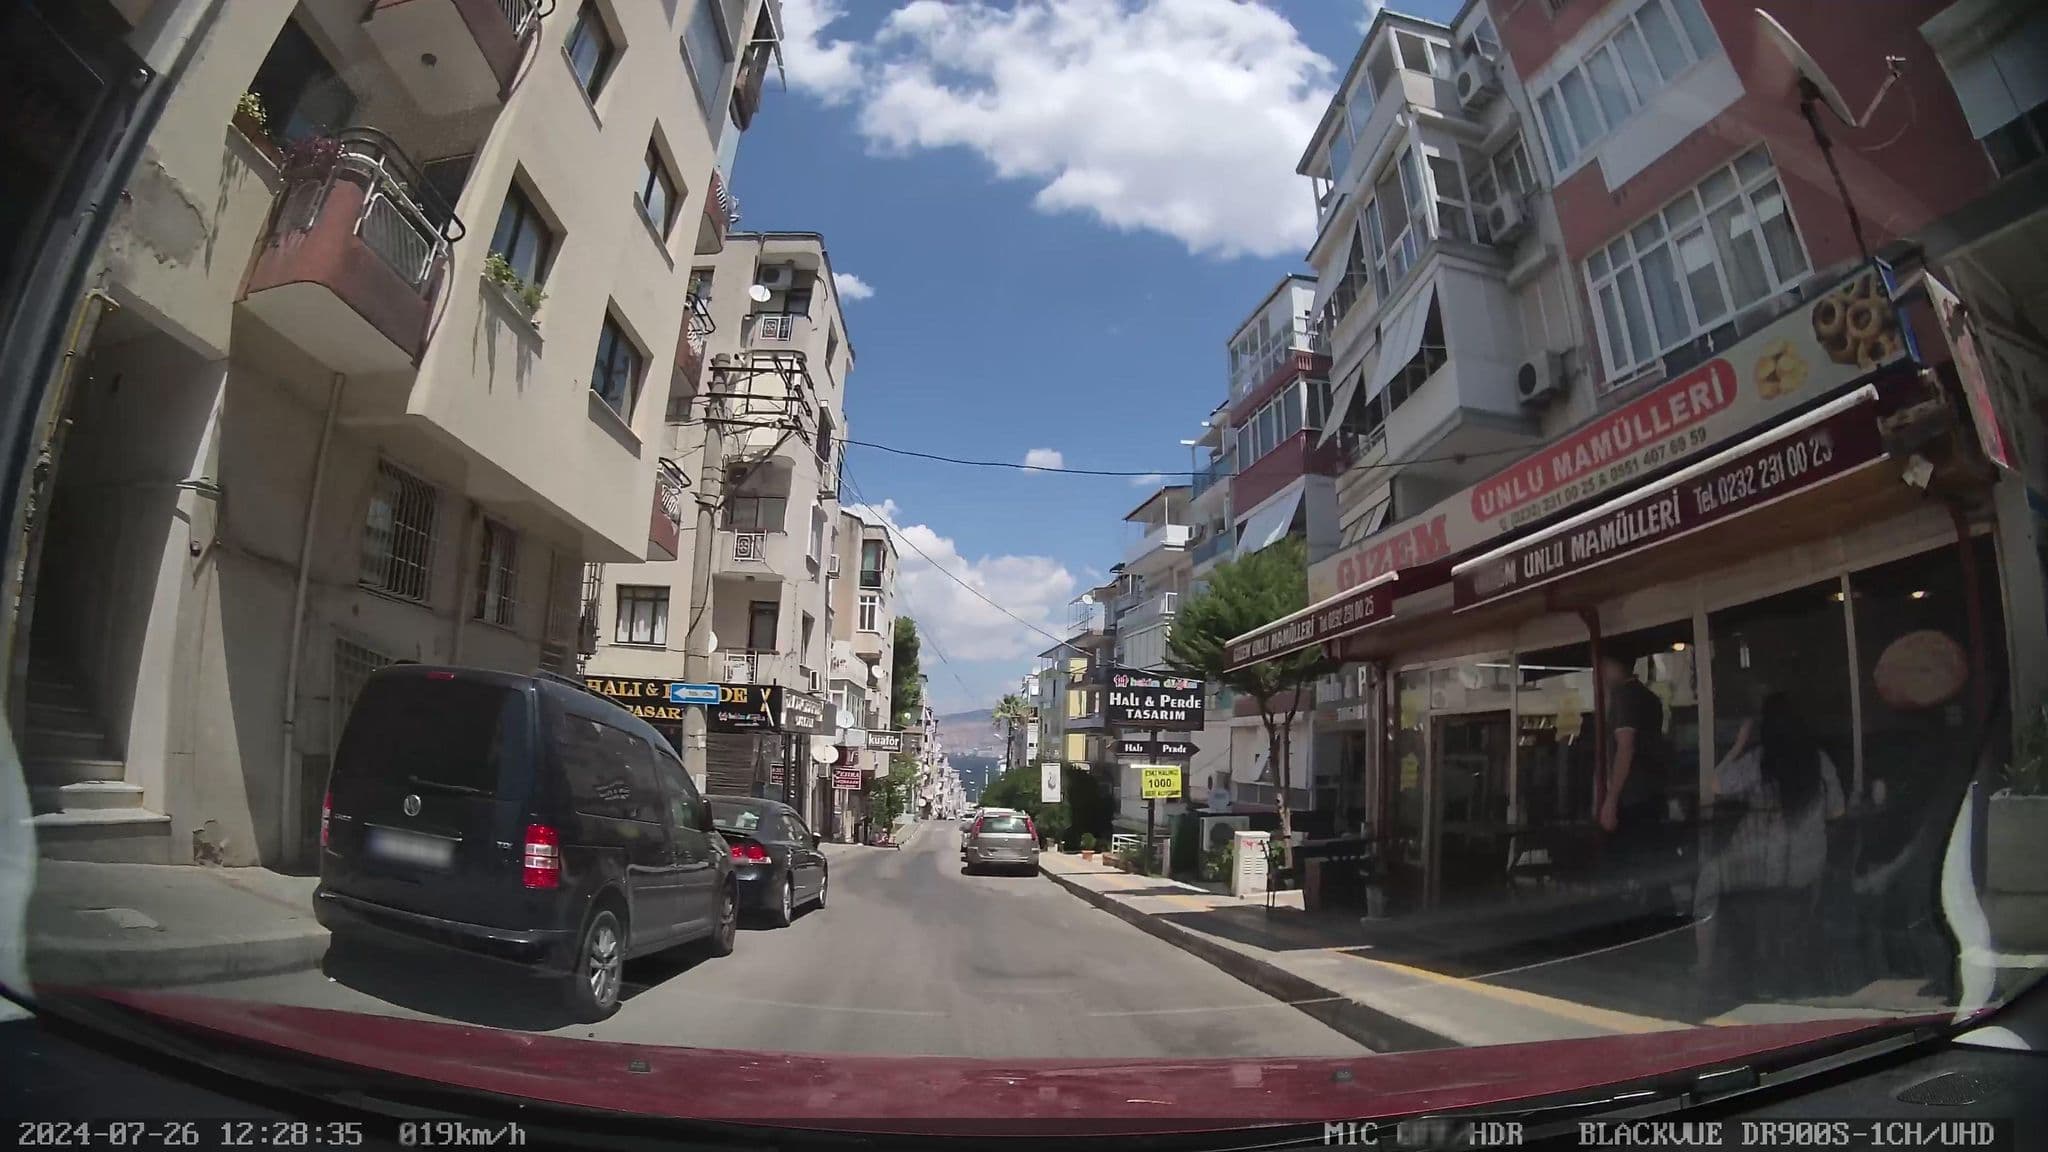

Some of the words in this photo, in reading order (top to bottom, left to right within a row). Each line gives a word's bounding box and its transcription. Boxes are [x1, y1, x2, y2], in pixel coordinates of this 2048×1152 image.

[1478, 464, 1546, 516] UNLU
[1552, 366, 1728, 483] MAMÜLLERİ
[1524, 541, 1565, 579] UNLU
[1570, 489, 1682, 563] MAMÜLLERİ
[1718, 464, 1756, 505] 0232
[1758, 452, 1786, 489] 231
[1786, 442, 1808, 477] 00
[585, 679, 642, 697] HALI
[645, 682, 659, 697] &
[1144, 695, 1155, 707] &
[1125, 708, 1185, 721] TASARIM
[1149, 778, 1172, 788] 1000
